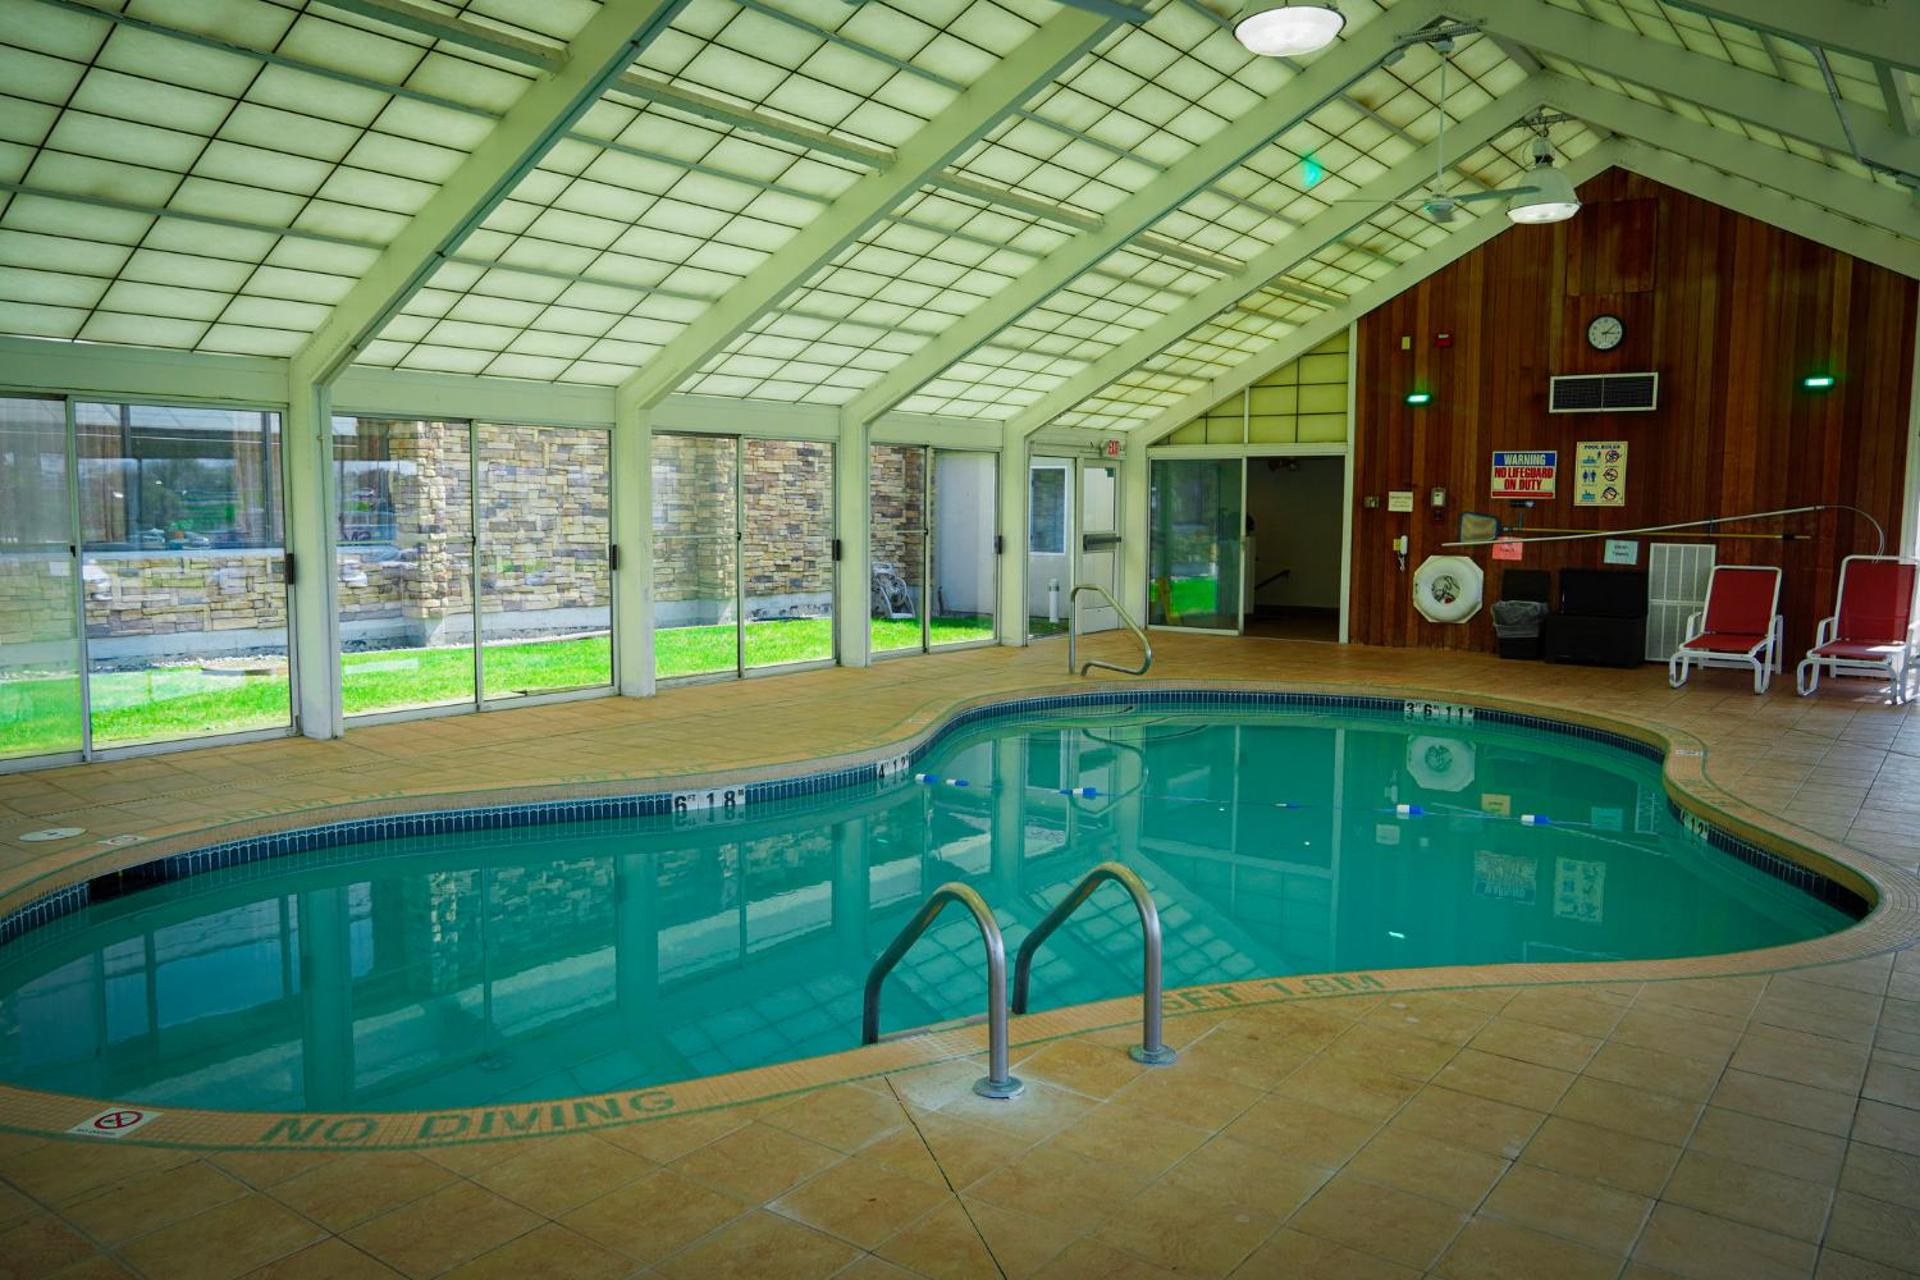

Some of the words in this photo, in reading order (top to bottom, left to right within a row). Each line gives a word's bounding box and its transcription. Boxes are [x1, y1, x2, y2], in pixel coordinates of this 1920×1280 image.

[1503, 453, 1546, 465] WARNING
[1494, 467, 1506, 478] NO
[1509, 467, 1554, 478] LIFEGUARD
[1504, 479, 1516, 490] ON
[1520, 479, 1543, 490] DUTY
[261, 1116, 377, 1143] NO
[417, 1090, 675, 1140] DIVING
